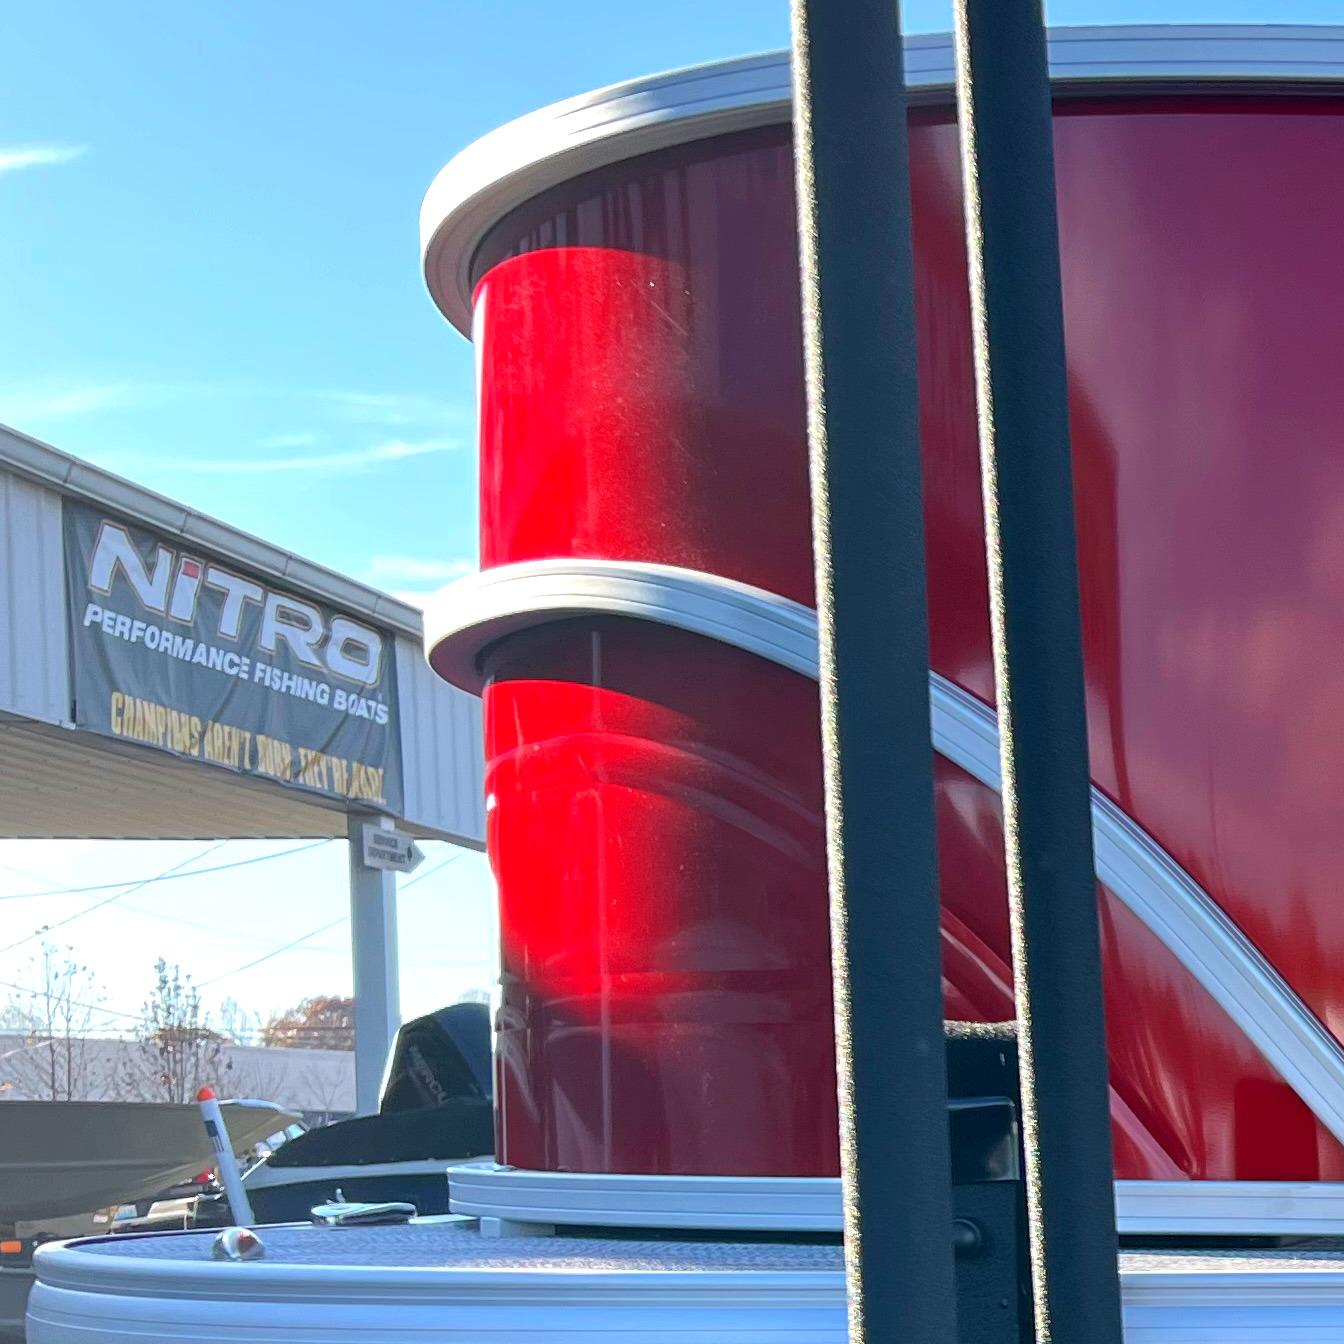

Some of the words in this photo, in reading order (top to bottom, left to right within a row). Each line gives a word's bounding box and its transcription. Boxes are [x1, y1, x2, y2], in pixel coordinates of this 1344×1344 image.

[83, 602, 250, 680] PERFORMANCE
[254, 661, 330, 704] FISHING
[333, 689, 389, 725] BOATS
[111, 691, 202, 757] CHAMPIONS
